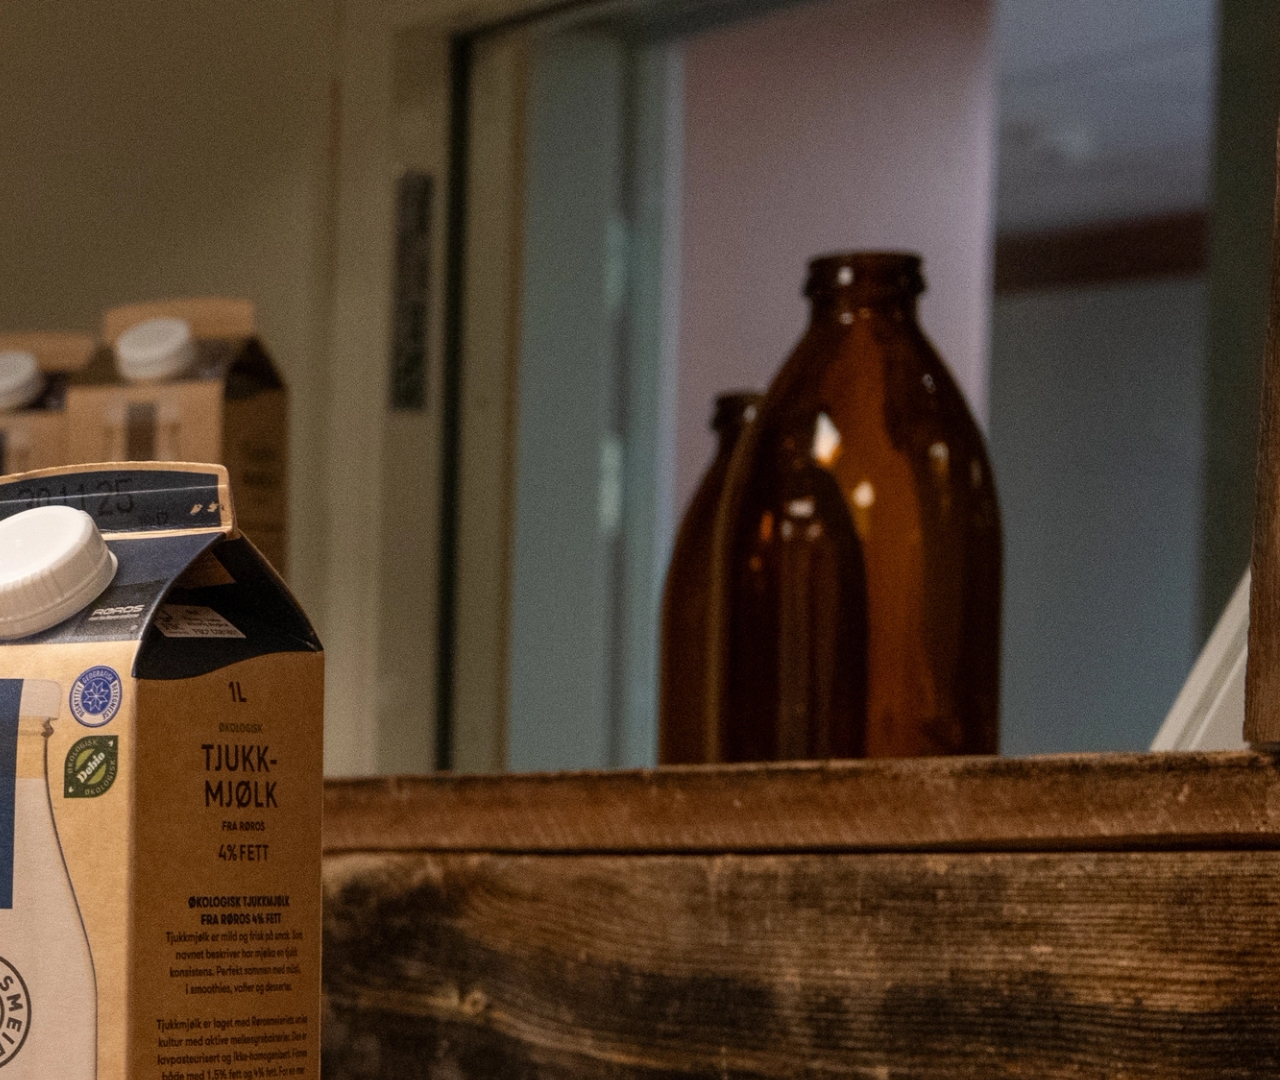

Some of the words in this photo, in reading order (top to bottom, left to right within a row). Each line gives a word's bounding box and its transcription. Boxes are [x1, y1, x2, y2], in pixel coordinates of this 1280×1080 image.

[228, 681, 247, 702] 1L
[218, 722, 263, 733] ØKOLOGISK
[67, 739, 98, 774] ØKOLOGISK
[201, 744, 278, 772] TJUKK-
[85, 760, 116, 796] ØKOLOGISK
[204, 780, 278, 808] MJØLK
[222, 821, 238, 832] FRA
[239, 820, 265, 832] RØROS
[218, 845, 238, 861] 4%
[239, 844, 269, 861] FETT
[188, 896, 241, 908] ØKOLOGISK
[201, 914, 218, 925] FRA
[221, 913, 250, 925] RØROS
[166, 932, 209, 944] Tjukkmjølk
[211, 934, 219, 942] er
[239, 933, 248, 944] og
[176, 951, 203, 960] navnet
[203, 1021, 211, 1029] er
[158, 1038, 183, 1047] kultur
[185, 1036, 203, 1046] med
[186, 1070, 204, 1080] med
